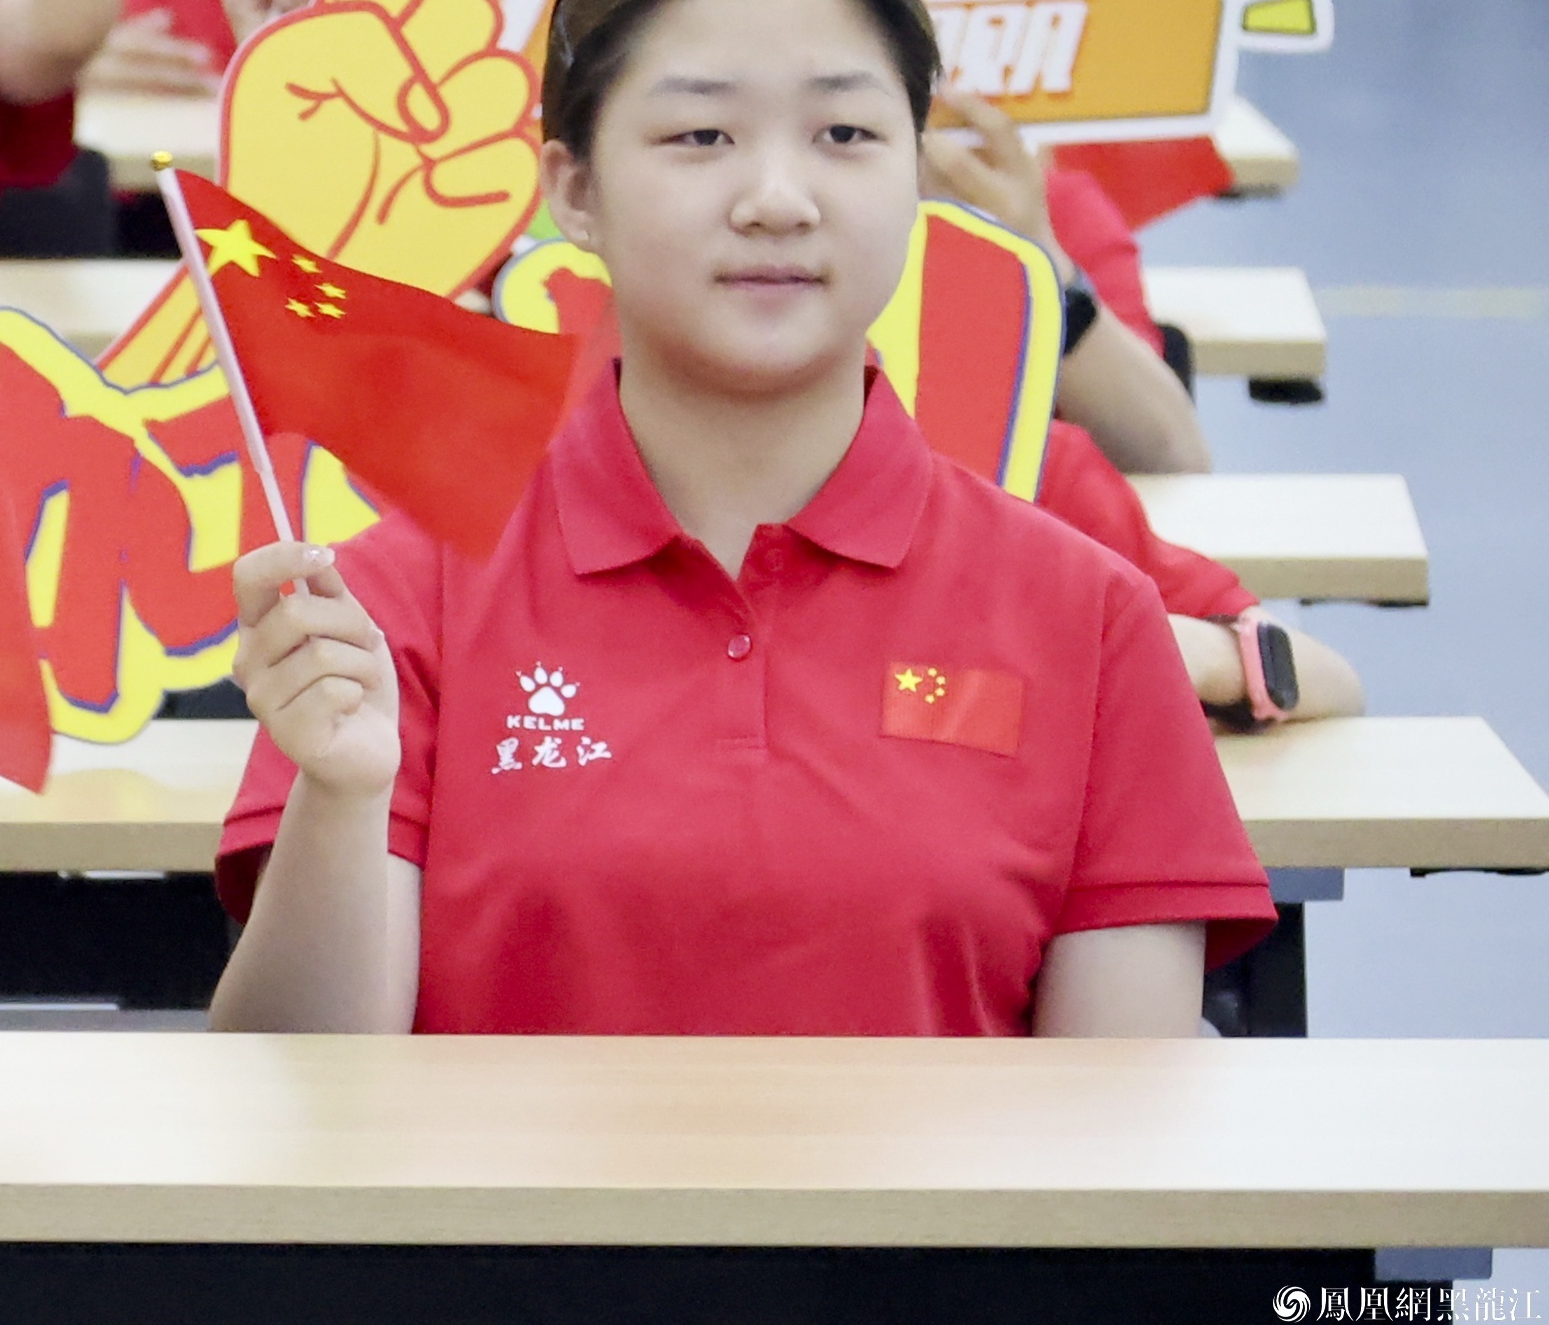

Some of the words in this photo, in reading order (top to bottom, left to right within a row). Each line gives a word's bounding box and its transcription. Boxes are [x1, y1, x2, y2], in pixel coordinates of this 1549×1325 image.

[506, 714, 585, 732] KELME
[490, 735, 613, 774] 黑龙江
